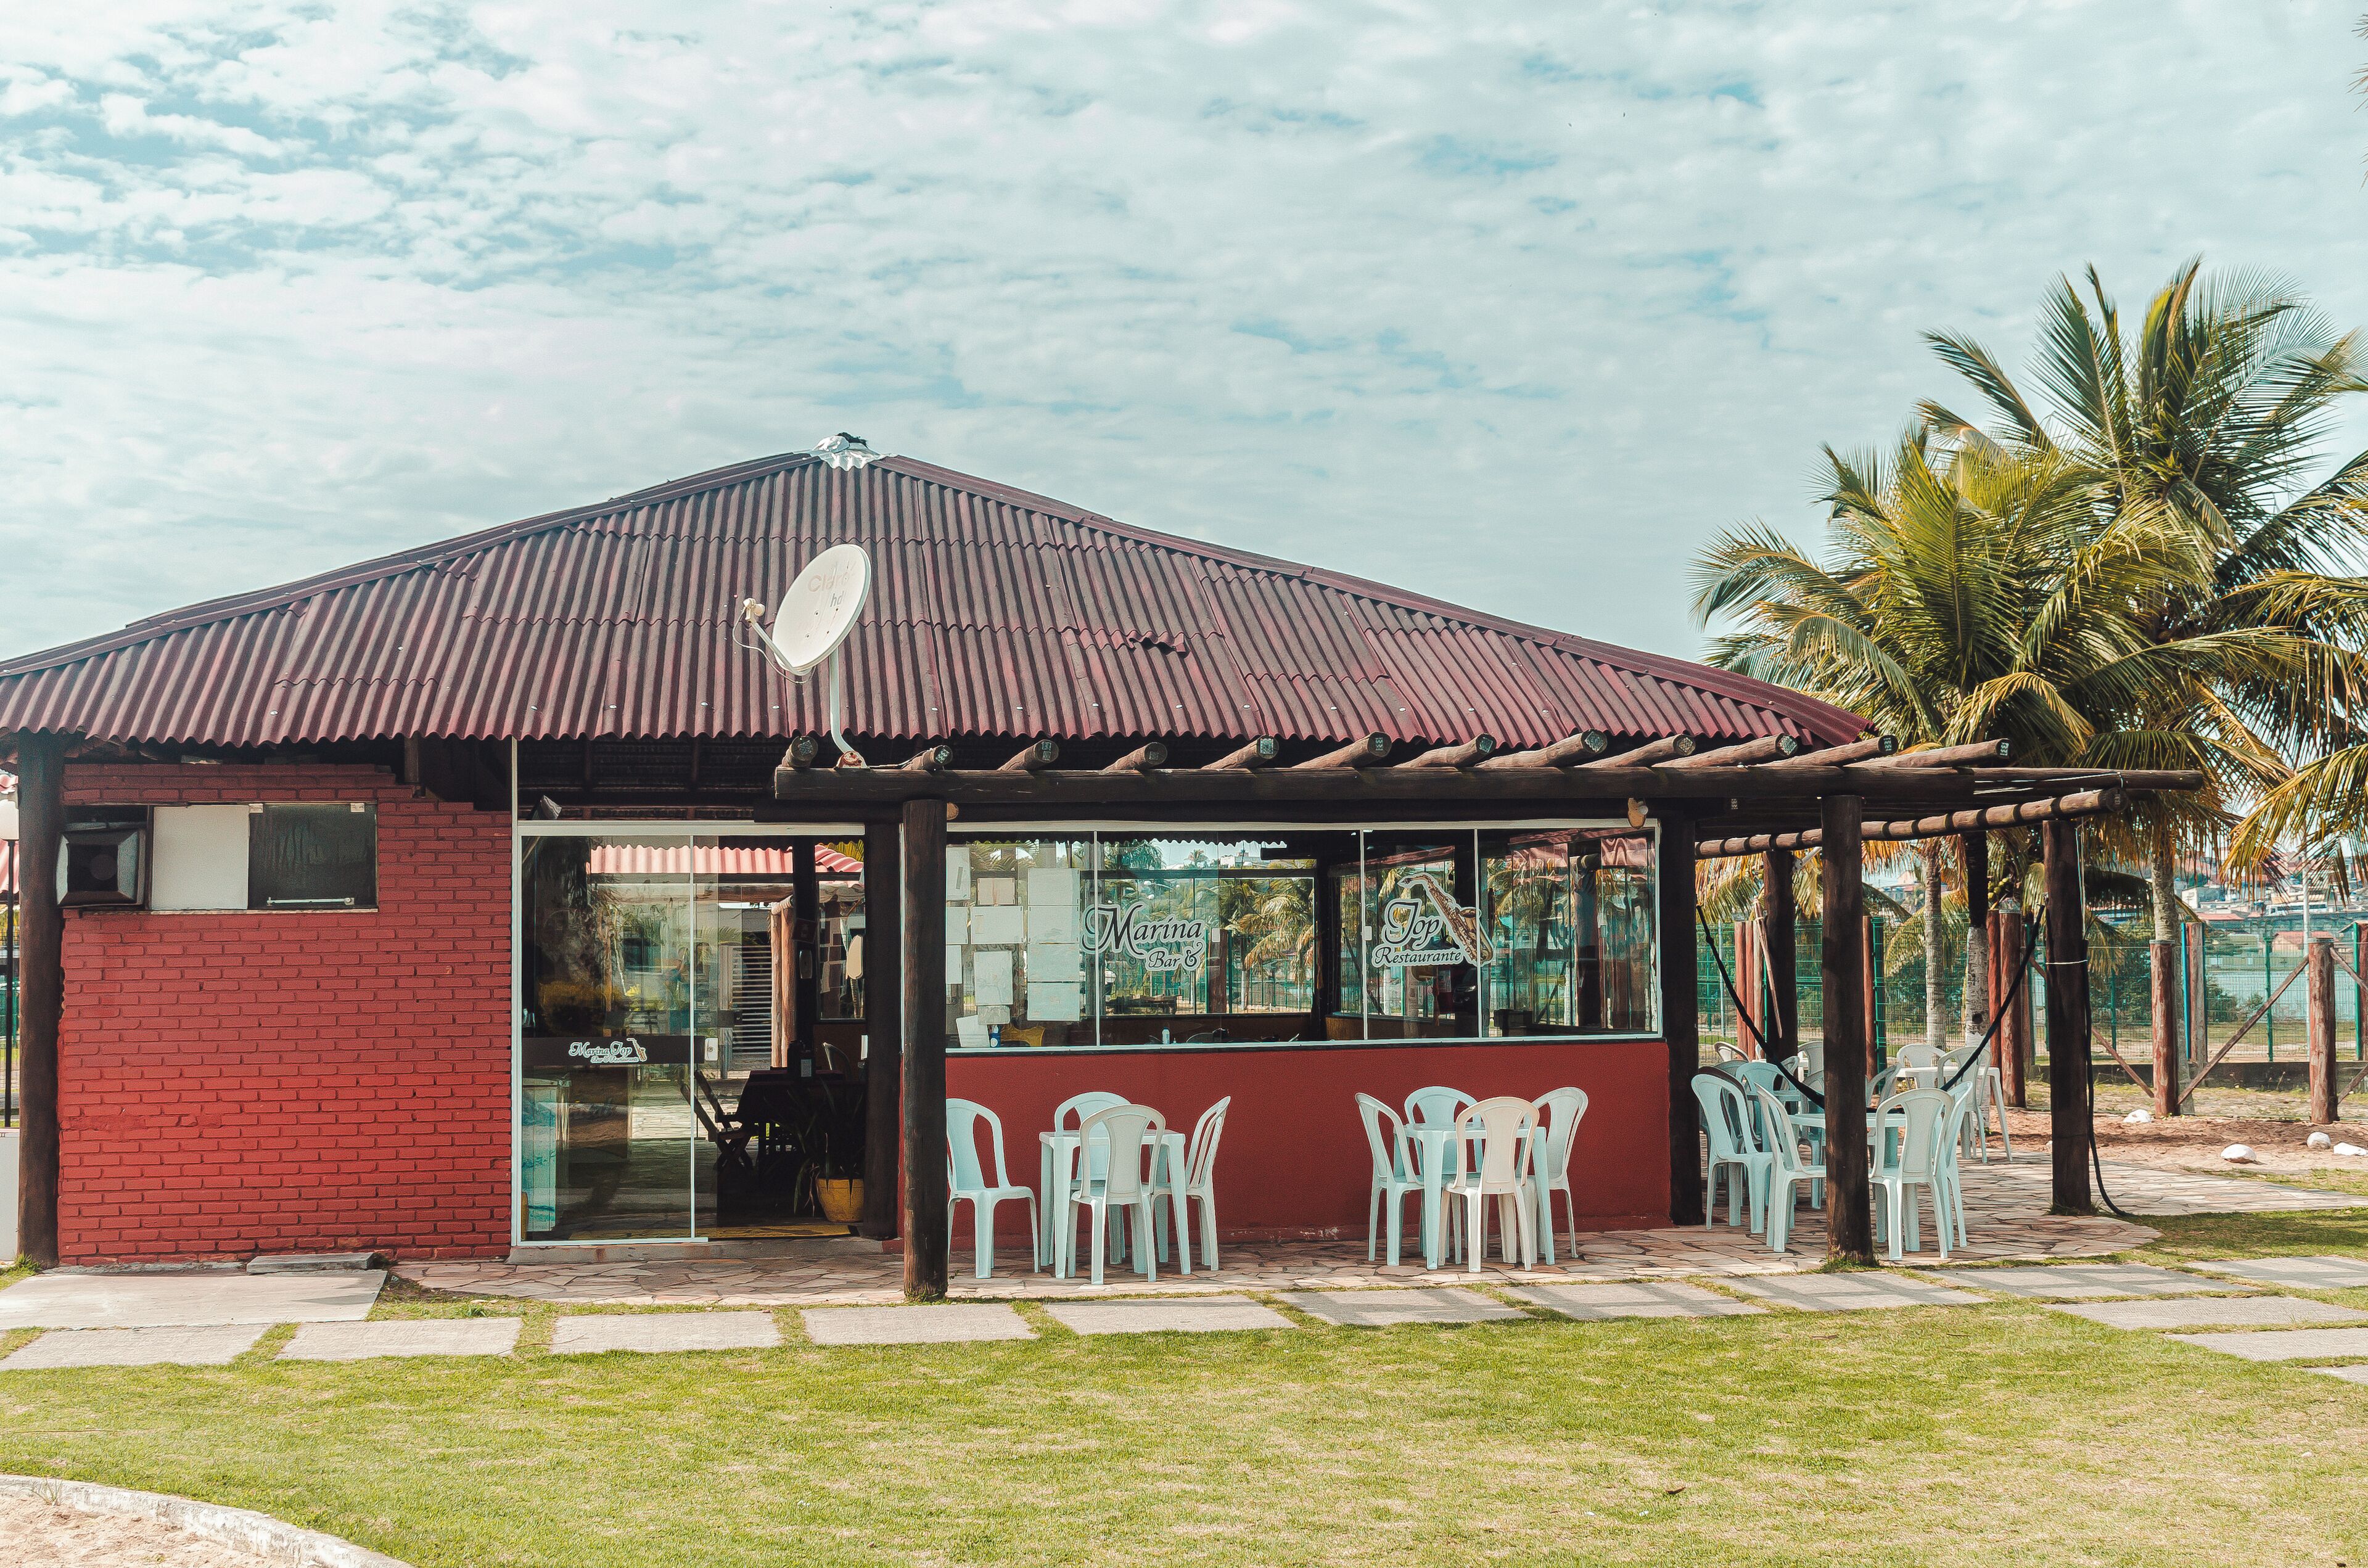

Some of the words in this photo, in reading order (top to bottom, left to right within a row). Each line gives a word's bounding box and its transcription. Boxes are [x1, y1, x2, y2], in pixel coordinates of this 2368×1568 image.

[1081, 904, 1202, 956] Marina
[1384, 901, 1440, 947] Top
[1148, 950, 1181, 968] Bar
[1184, 941, 1204, 967] &
[1375, 946, 1462, 964] Restaurante
[569, 1042, 609, 1057] Marina
[610, 1041, 632, 1057] Top
